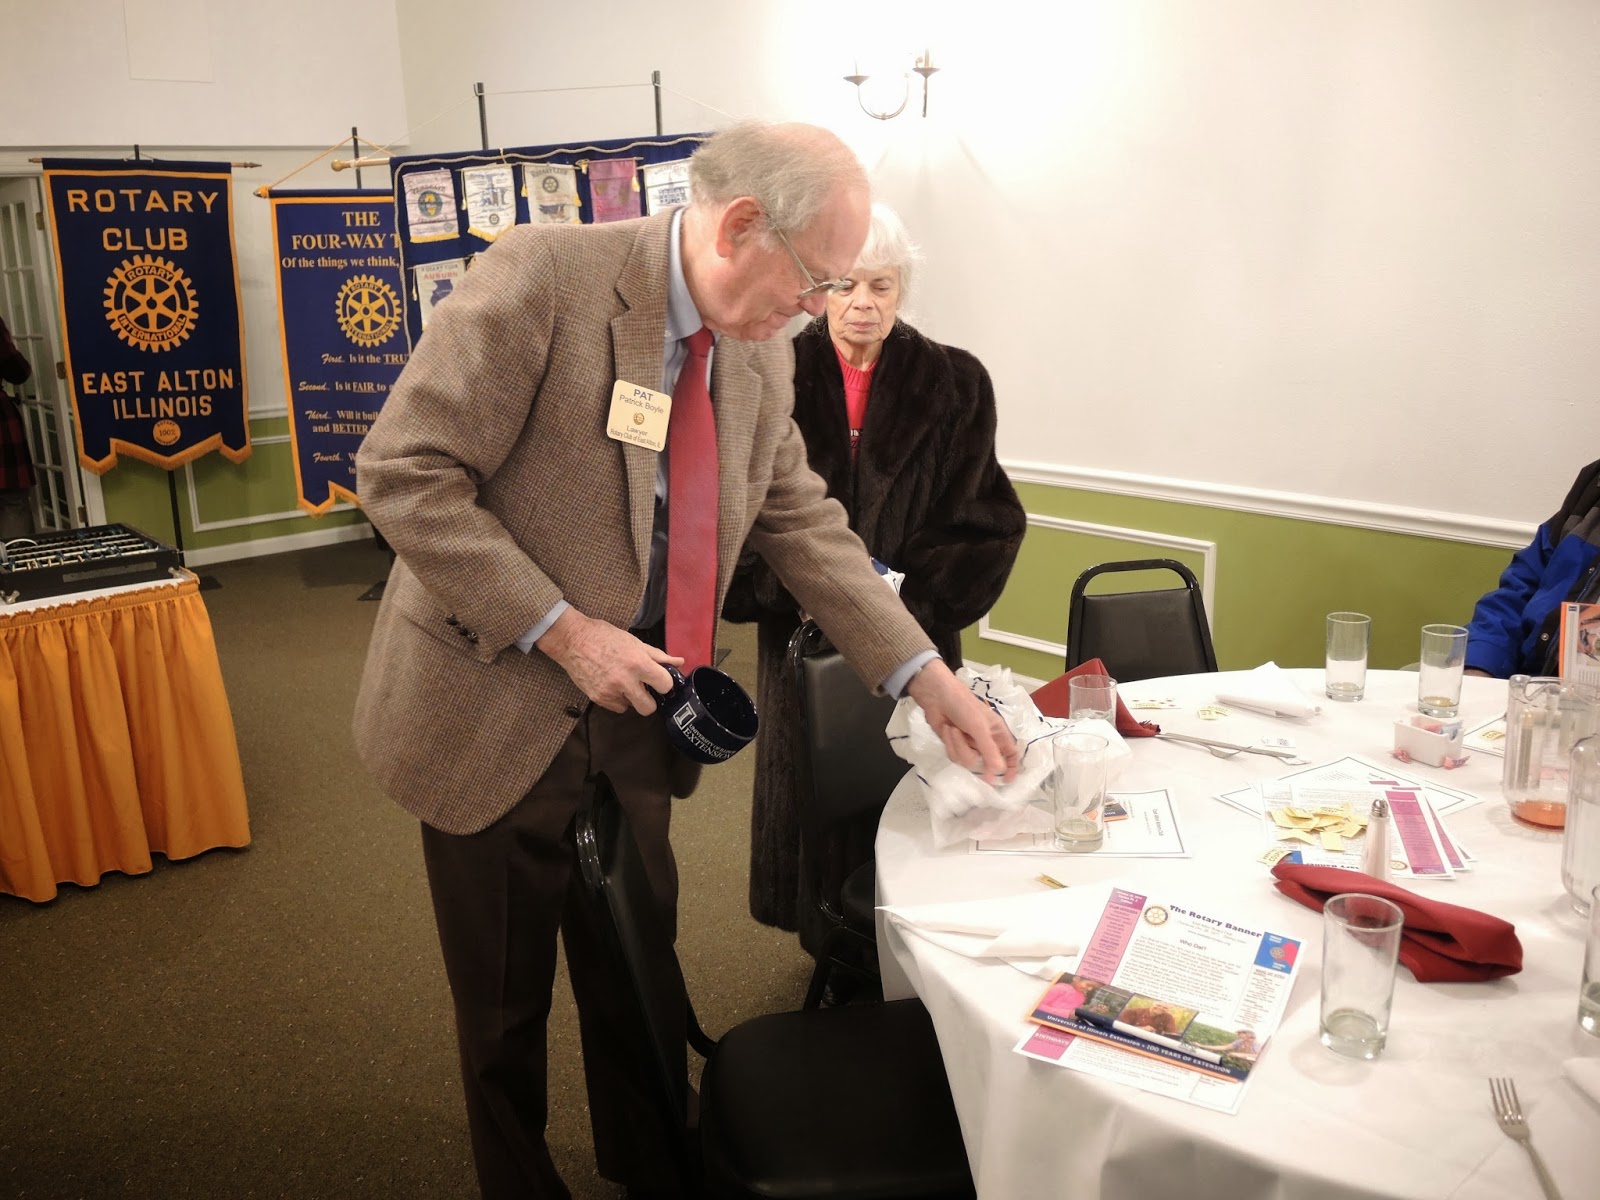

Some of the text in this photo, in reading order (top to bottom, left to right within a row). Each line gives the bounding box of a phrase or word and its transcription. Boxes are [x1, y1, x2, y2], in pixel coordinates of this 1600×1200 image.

[67, 189, 218, 213] ROTARY
[342, 211, 380, 227] THE
[102, 228, 188, 251] CLUB
[292, 234, 386, 250] FOUR-WAY
[282, 256, 400, 270] Of the things we think,
[127, 266, 173, 280] ROTARY
[350, 282, 379, 292] ROTARY
[118, 314, 186, 340] INTERNATIONAL
[350, 354, 356, 363] Is
[360, 354, 366, 363] it
[366, 354, 381, 363] the
[383, 354, 410, 363] TRU
[82, 368, 234, 394] EAST ALTON
[336, 382, 343, 390] Is
[345, 382, 351, 390] it
[353, 382, 374, 391] FAIR
[377, 382, 386, 391] to
[634, 389, 654, 401] PAT
[113, 396, 212, 420] ILLINOIS
[620, 394, 664, 414] Patrick Boyle
[337, 410, 354, 420] Will
[363, 412, 379, 420] buil
[313, 424, 369, 432] and BETTER
[610, 428, 624, 438] Rotary
[624, 432, 632, 440] Club
[627, 425, 648, 436] Lawyer
[682, 727, 730, 758] EXTENSION
[689, 724, 713, 747] UNIVERSITY
[1170, 905, 1186, 914] The
[1189, 912, 1222, 926] Rotary
[1225, 923, 1262, 938] Banner
[1180, 939, 1192, 947] Who
[1034, 1033, 1070, 1045] BIRTHDAYS
[1047, 1015, 1077, 1028] University
[1086, 1026, 1108, 1037] Illinois
[1110, 1034, 1140, 1046] Extension
[1161, 1048, 1181, 1059] YEARS
[1192, 1059, 1232, 1074] EXTENSION
